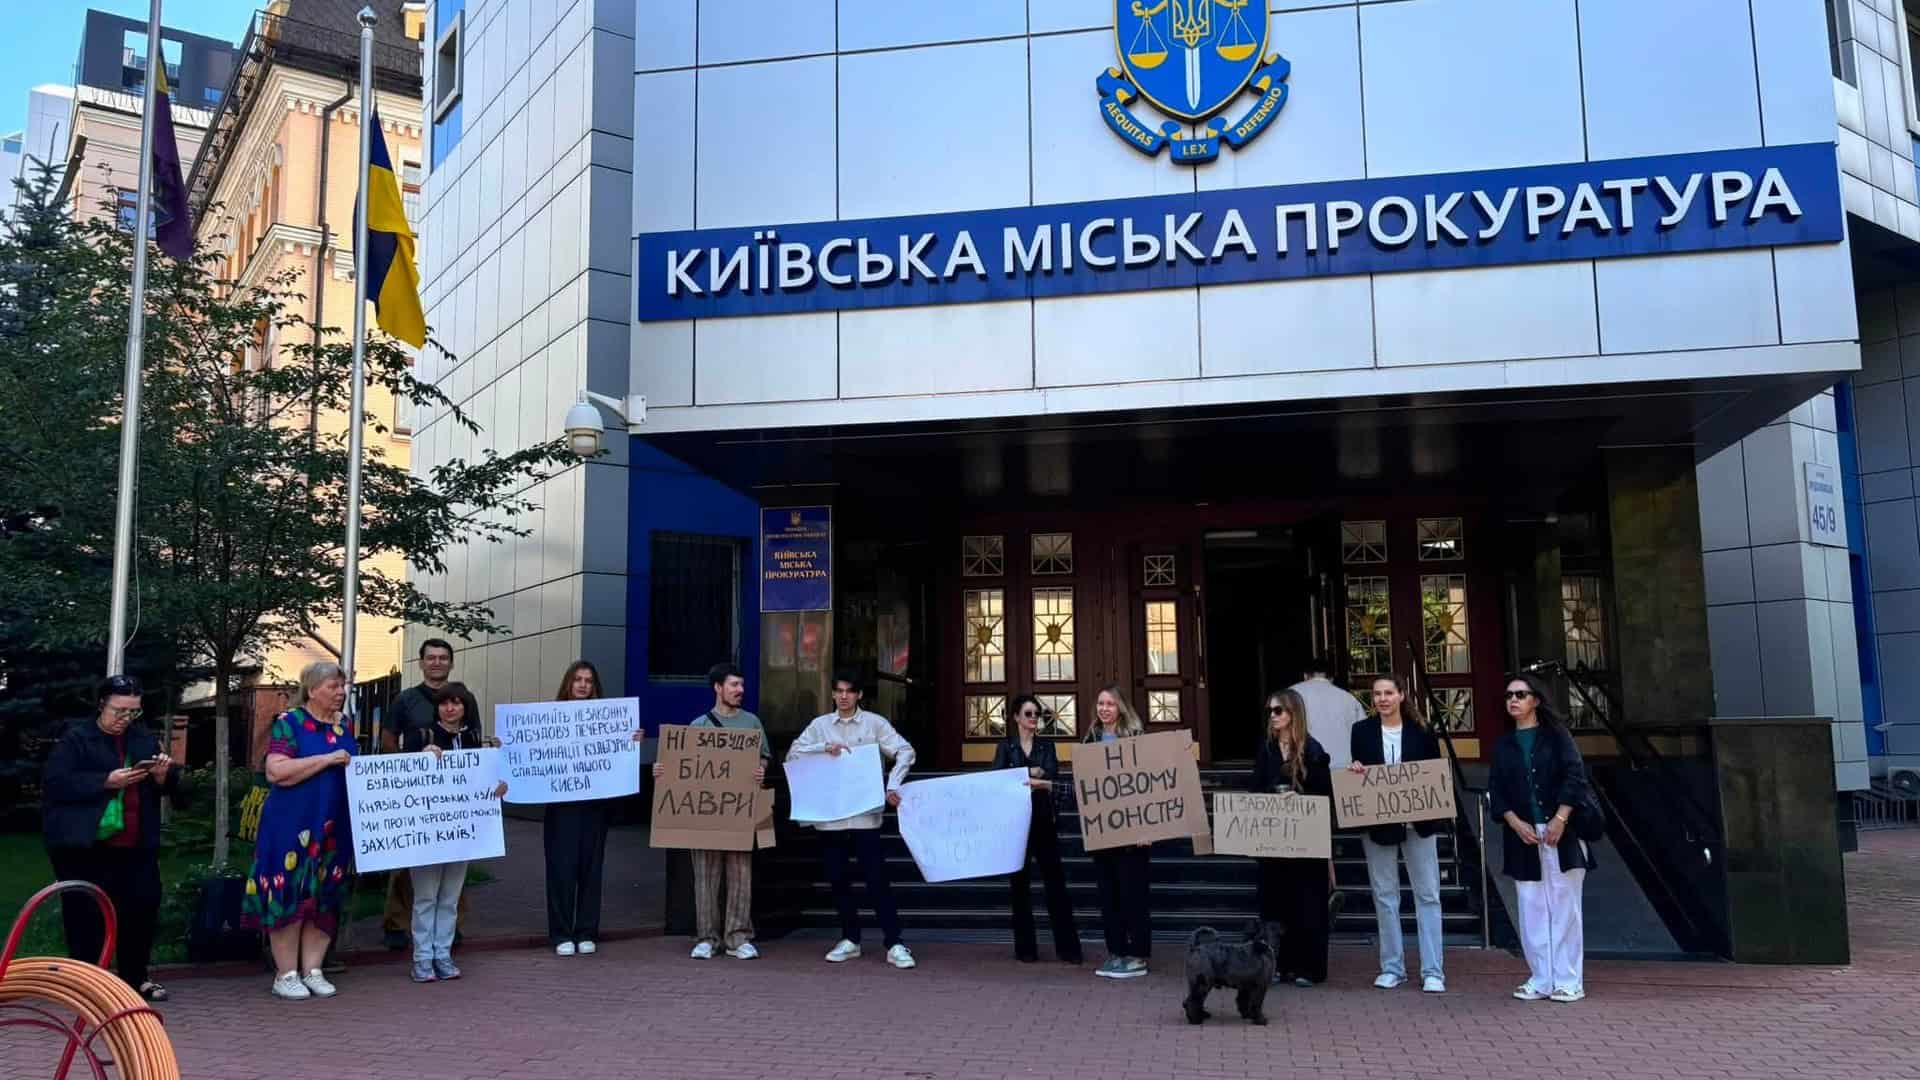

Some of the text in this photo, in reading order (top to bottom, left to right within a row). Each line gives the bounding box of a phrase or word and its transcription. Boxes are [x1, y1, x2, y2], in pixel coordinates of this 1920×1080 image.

[1105, 88, 1282, 156] AEQUITAS LEX DEFENSIO
[666, 167, 1802, 295] КИЇВСЬКА МІСЬКА ПРОКУРАТУРА
[1813, 504, 1836, 534] 45/9
[765, 570, 827, 580] ПРОКУРАТУРА
[505, 706, 628, 728] ПРИПИНІТЬ НЕЗАКОННУ
[503, 719, 633, 746] ЗАБУДОВУ ПЕЧЕРСЬКУ!
[529, 742, 580, 761] РУЙНАЦІЇ
[355, 752, 480, 776] ВИМАГАЄМО АРЕШТУ
[511, 760, 612, 778] СПАДЩИНИ НАШОГО
[366, 773, 467, 791] БУДІВНИЦТВА НА
[550, 775, 591, 793] КИЄВА
[1080, 767, 1177, 806] НОВОМУ
[657, 788, 754, 818] ЛАВРИ
[1341, 795, 1365, 817] НЕ
[361, 821, 380, 833] МИ
[384, 815, 416, 831] ПРОТИ
[419, 809, 469, 824] ЧЕРГОВОГО
[1083, 796, 1185, 836] МОНСТРУ
[1225, 815, 1304, 840] МАФІЇ
